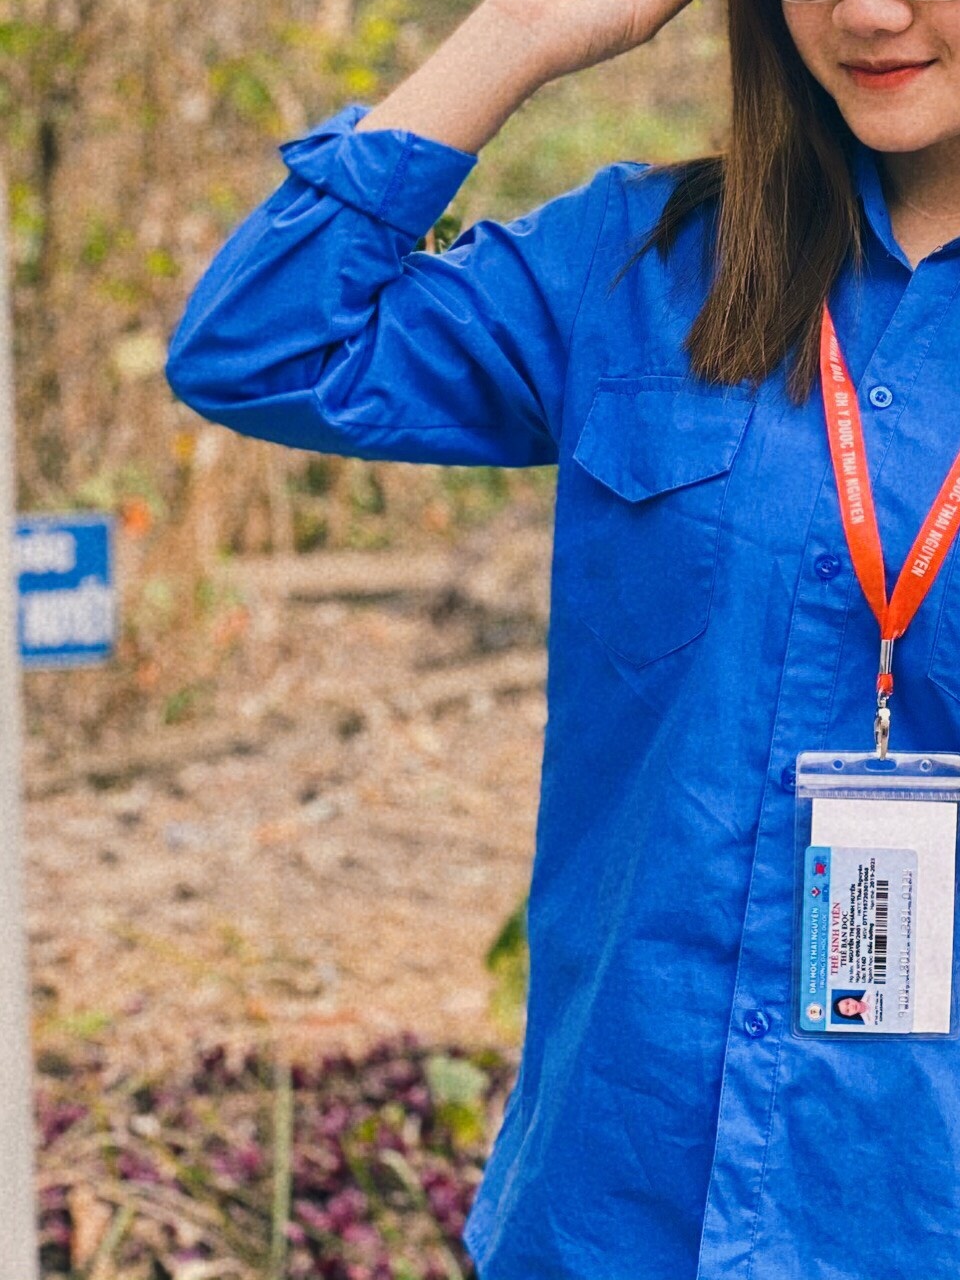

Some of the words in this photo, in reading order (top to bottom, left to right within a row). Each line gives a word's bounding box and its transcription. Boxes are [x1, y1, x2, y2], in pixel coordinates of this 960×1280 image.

[831, 902, 840, 926] VIÊN
[831, 929, 839, 953] SINH
[829, 955, 838, 975] THẺ
